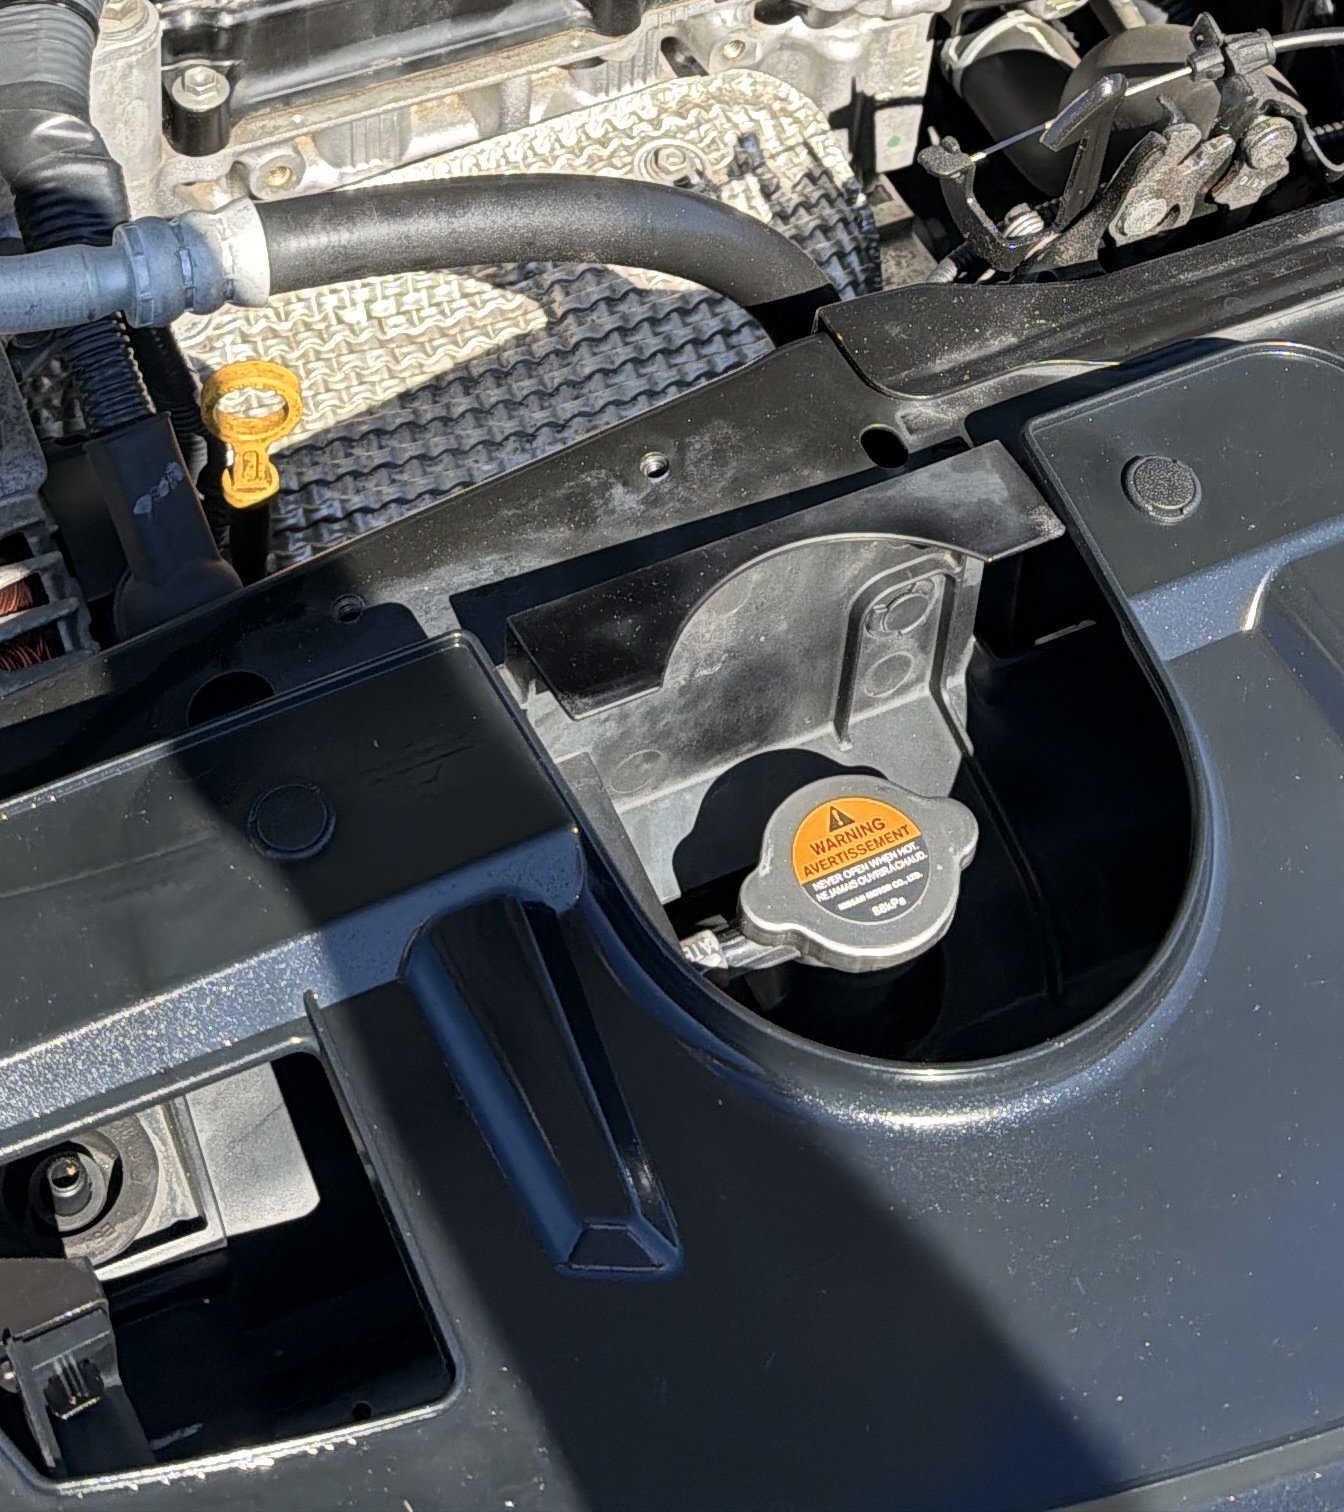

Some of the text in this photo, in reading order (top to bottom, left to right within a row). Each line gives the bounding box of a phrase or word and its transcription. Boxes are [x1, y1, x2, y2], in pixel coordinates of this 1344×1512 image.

[802, 825, 912, 877] AVERTISSEMENT
[810, 818, 886, 856] WARNING
[813, 873, 843, 891] NEVER
[843, 863, 869, 879] OPEN
[869, 851, 898, 869] WHEN
